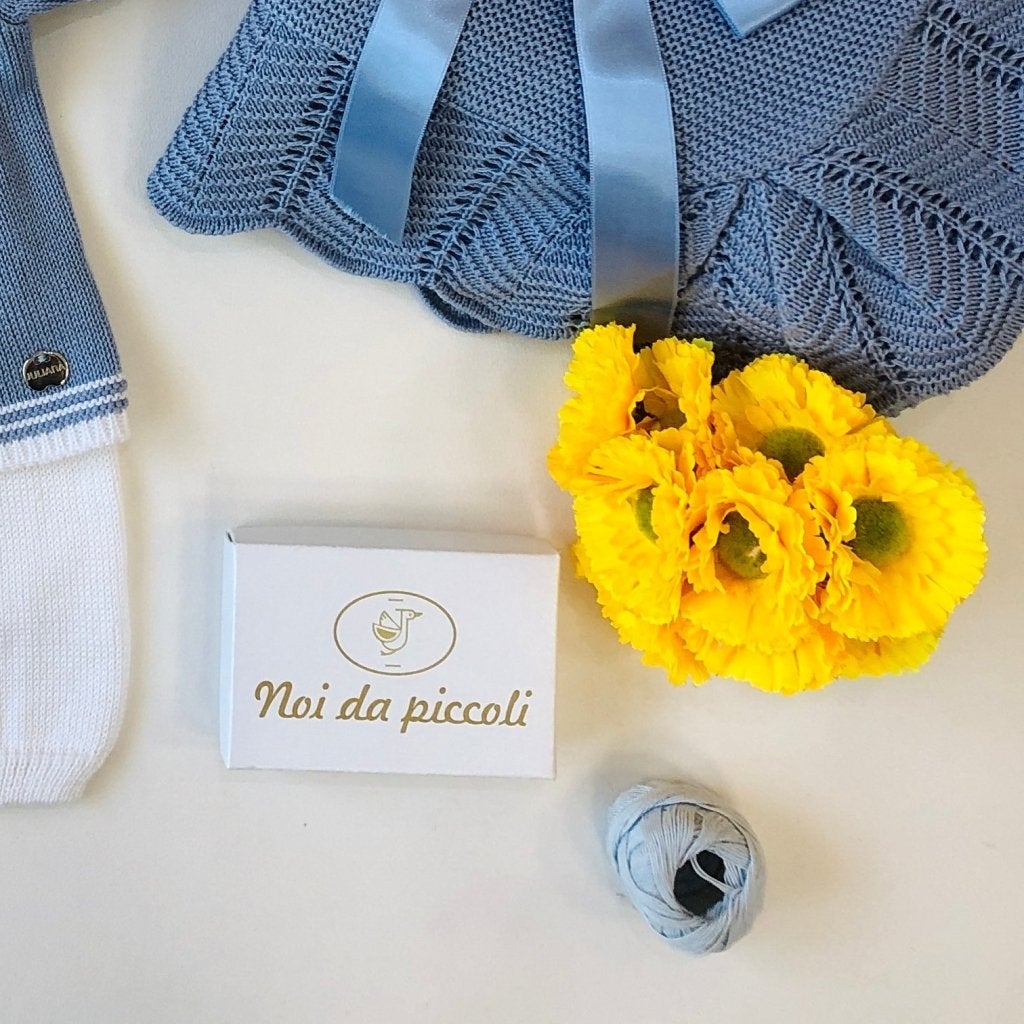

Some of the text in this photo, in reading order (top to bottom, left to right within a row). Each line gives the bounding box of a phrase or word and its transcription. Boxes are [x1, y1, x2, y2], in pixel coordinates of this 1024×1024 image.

[255, 680, 533, 734] Noi da piccoli
